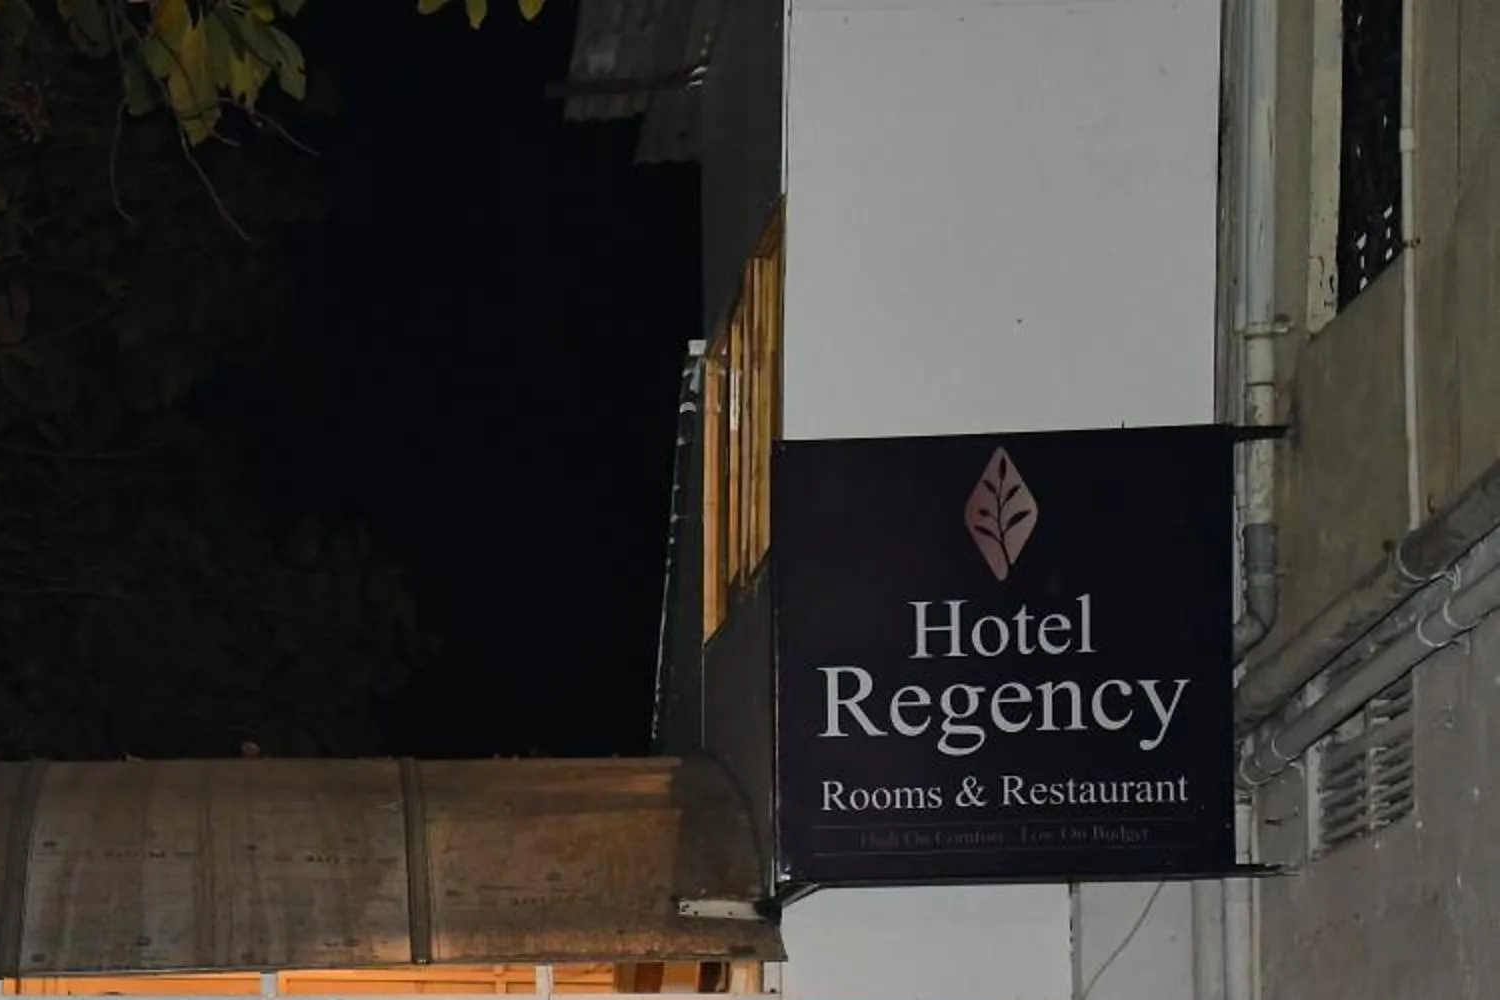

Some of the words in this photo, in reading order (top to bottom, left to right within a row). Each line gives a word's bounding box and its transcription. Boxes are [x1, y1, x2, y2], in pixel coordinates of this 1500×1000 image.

[907, 593, 1098, 659] Hotel
[816, 665, 1191, 757] Regency
[821, 779, 943, 811] Rooms
[955, 775, 987, 807] &
[1002, 774, 1189, 806] Restaurant
